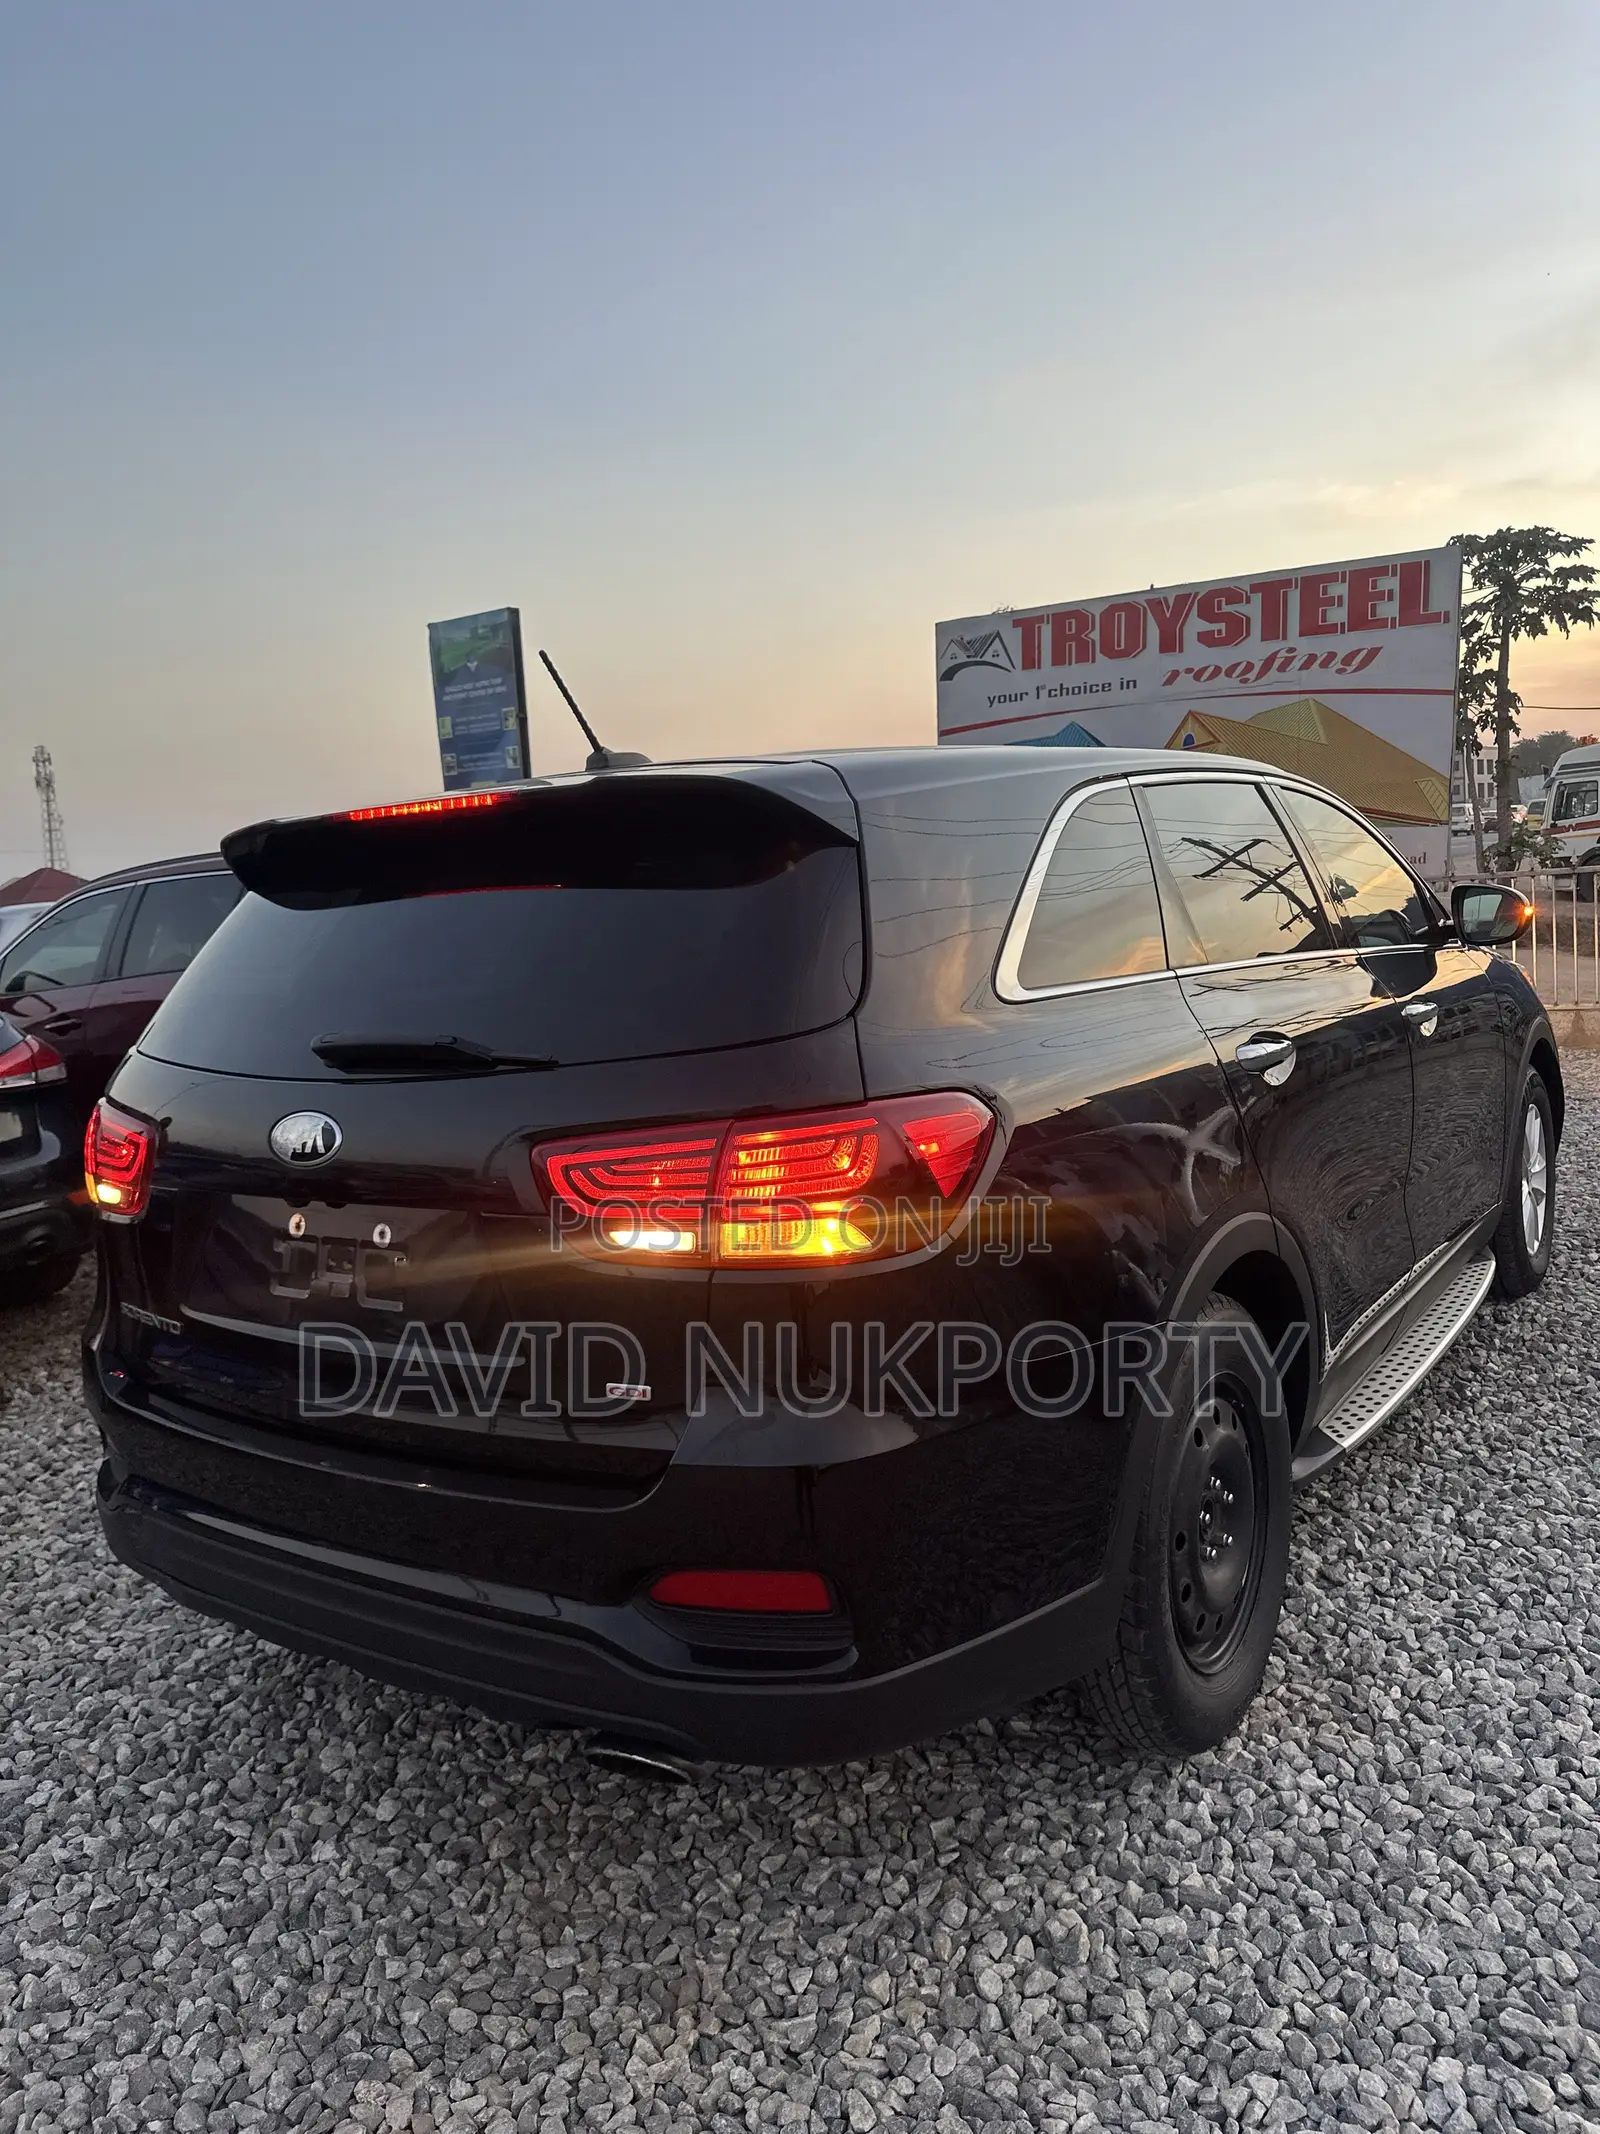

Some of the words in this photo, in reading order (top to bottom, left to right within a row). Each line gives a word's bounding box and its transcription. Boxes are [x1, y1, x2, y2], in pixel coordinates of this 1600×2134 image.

[1012, 560, 1450, 671] TROYSTEEL
[1161, 646, 1384, 687] roofing
[987, 691, 1029, 708] your
[1048, 681, 1112, 698] choice
[1120, 677, 1138, 691] in
[609, 1386, 648, 1399] GDI
